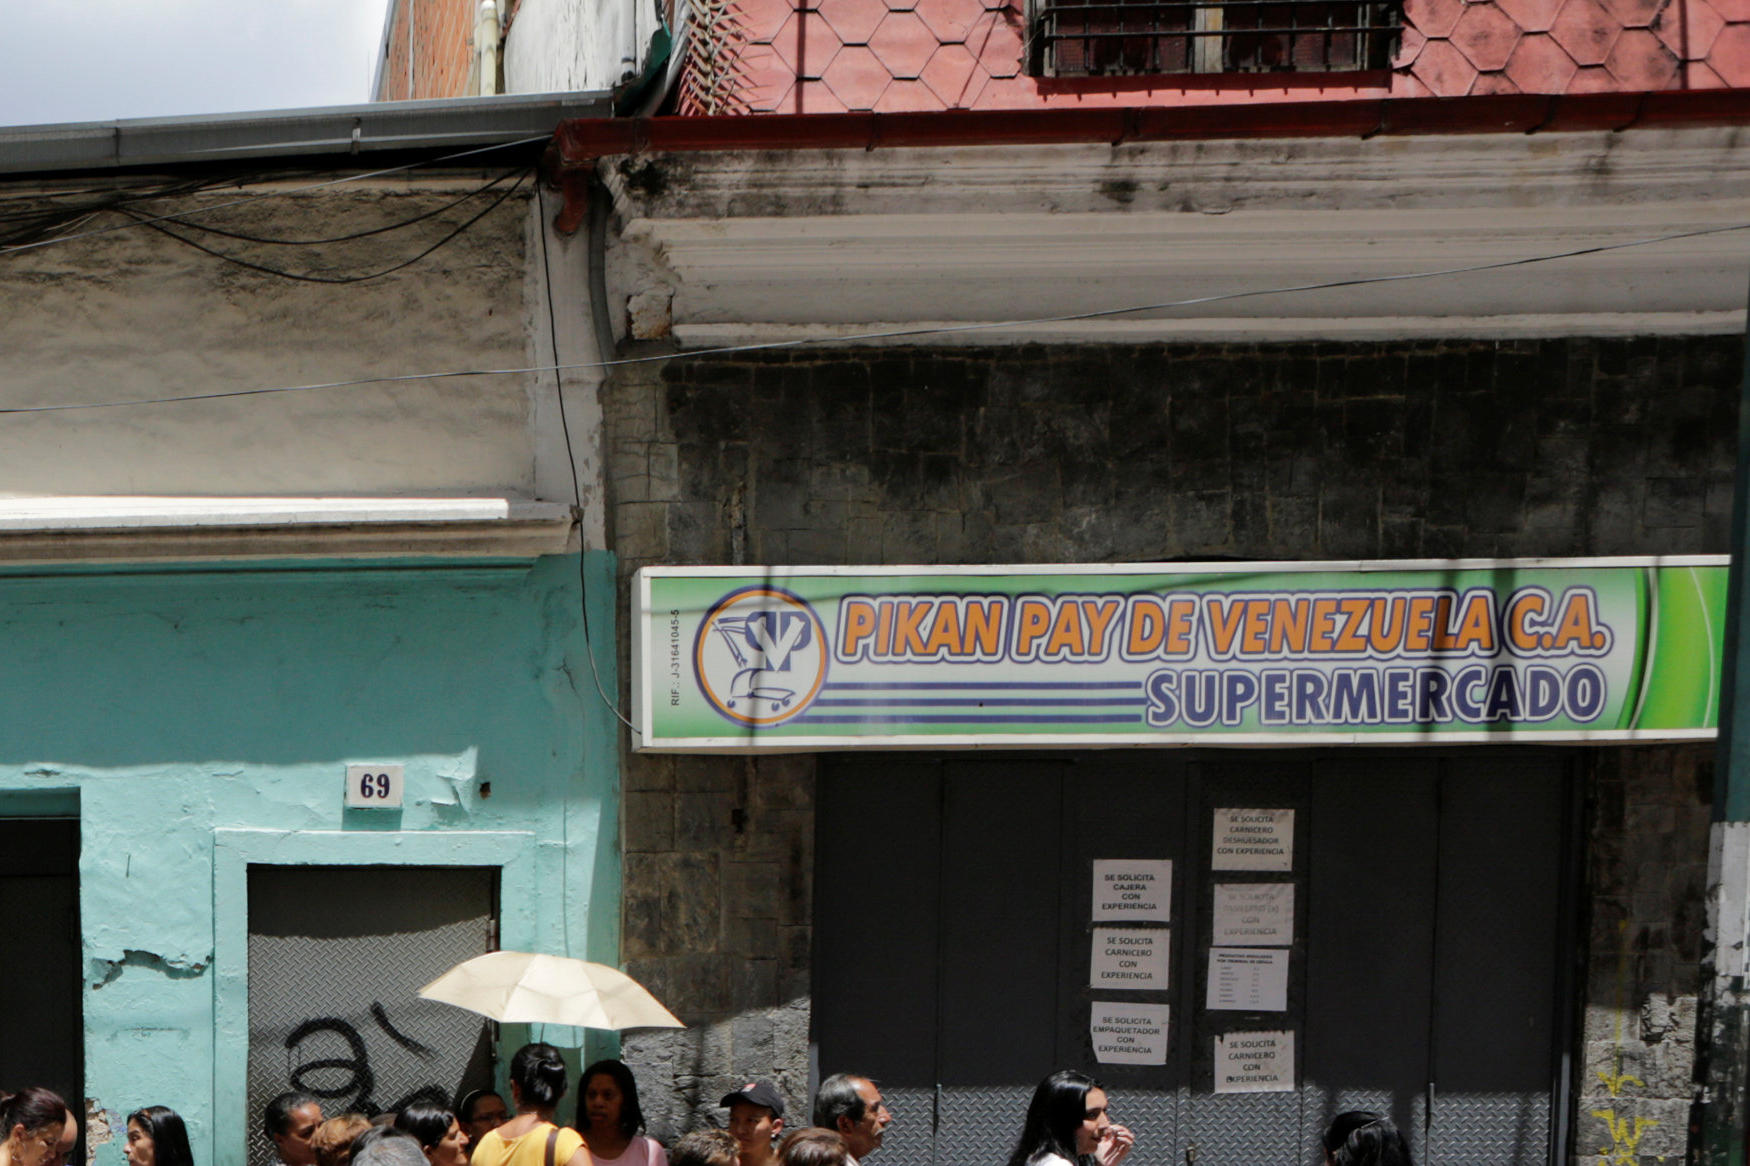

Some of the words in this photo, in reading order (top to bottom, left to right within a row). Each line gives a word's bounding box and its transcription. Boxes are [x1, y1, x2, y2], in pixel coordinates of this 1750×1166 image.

[840, 596, 1006, 660] PIKAN
[1013, 596, 1123, 660] PAY
[1124, 595, 1198, 659] DE
[1205, 592, 1498, 657] VENEZUELA
[1505, 588, 1611, 656] C.A.
[1148, 665, 1605, 726] SUPERMERCADO
[360, 773, 391, 799] 69
[1230, 815, 1238, 823] SE
[1240, 815, 1274, 823] SOLICITA
[1229, 826, 1274, 834] CARNICERO
[1216, 847, 1234, 855] CON
[1235, 847, 1285, 855] EXPERIENCIA
[1104, 873, 1115, 881] SE
[1117, 873, 1155, 881] SOLICITA
[1113, 883, 1147, 891] CAJERA
[1121, 893, 1141, 901] CON
[1101, 902, 1157, 910] EXPERIENCIA
[1106, 936, 1117, 944] SE
[1119, 936, 1154, 945] SOLICITA
[1105, 948, 1153, 957] CARNICERO
[1118, 960, 1138, 968] CON
[1100, 971, 1154, 980] EXPERIENCIA
[1102, 1016, 1113, 1024] SE
[1115, 1016, 1152, 1025] SOLICITA
[1092, 1026, 1161, 1035] EMPAQUETADOR
[1116, 1036, 1135, 1044] CON
[1229, 1041, 1239, 1049] SE
[1240, 1040, 1277, 1049] SOLICITA
[1098, 1045, 1153, 1054] EXPERIENCIA
[1228, 1051, 1276, 1060] CARNICERO
[1242, 1063, 1261, 1071] CON
[1225, 1074, 1279, 1084] EXPERIENCIA
